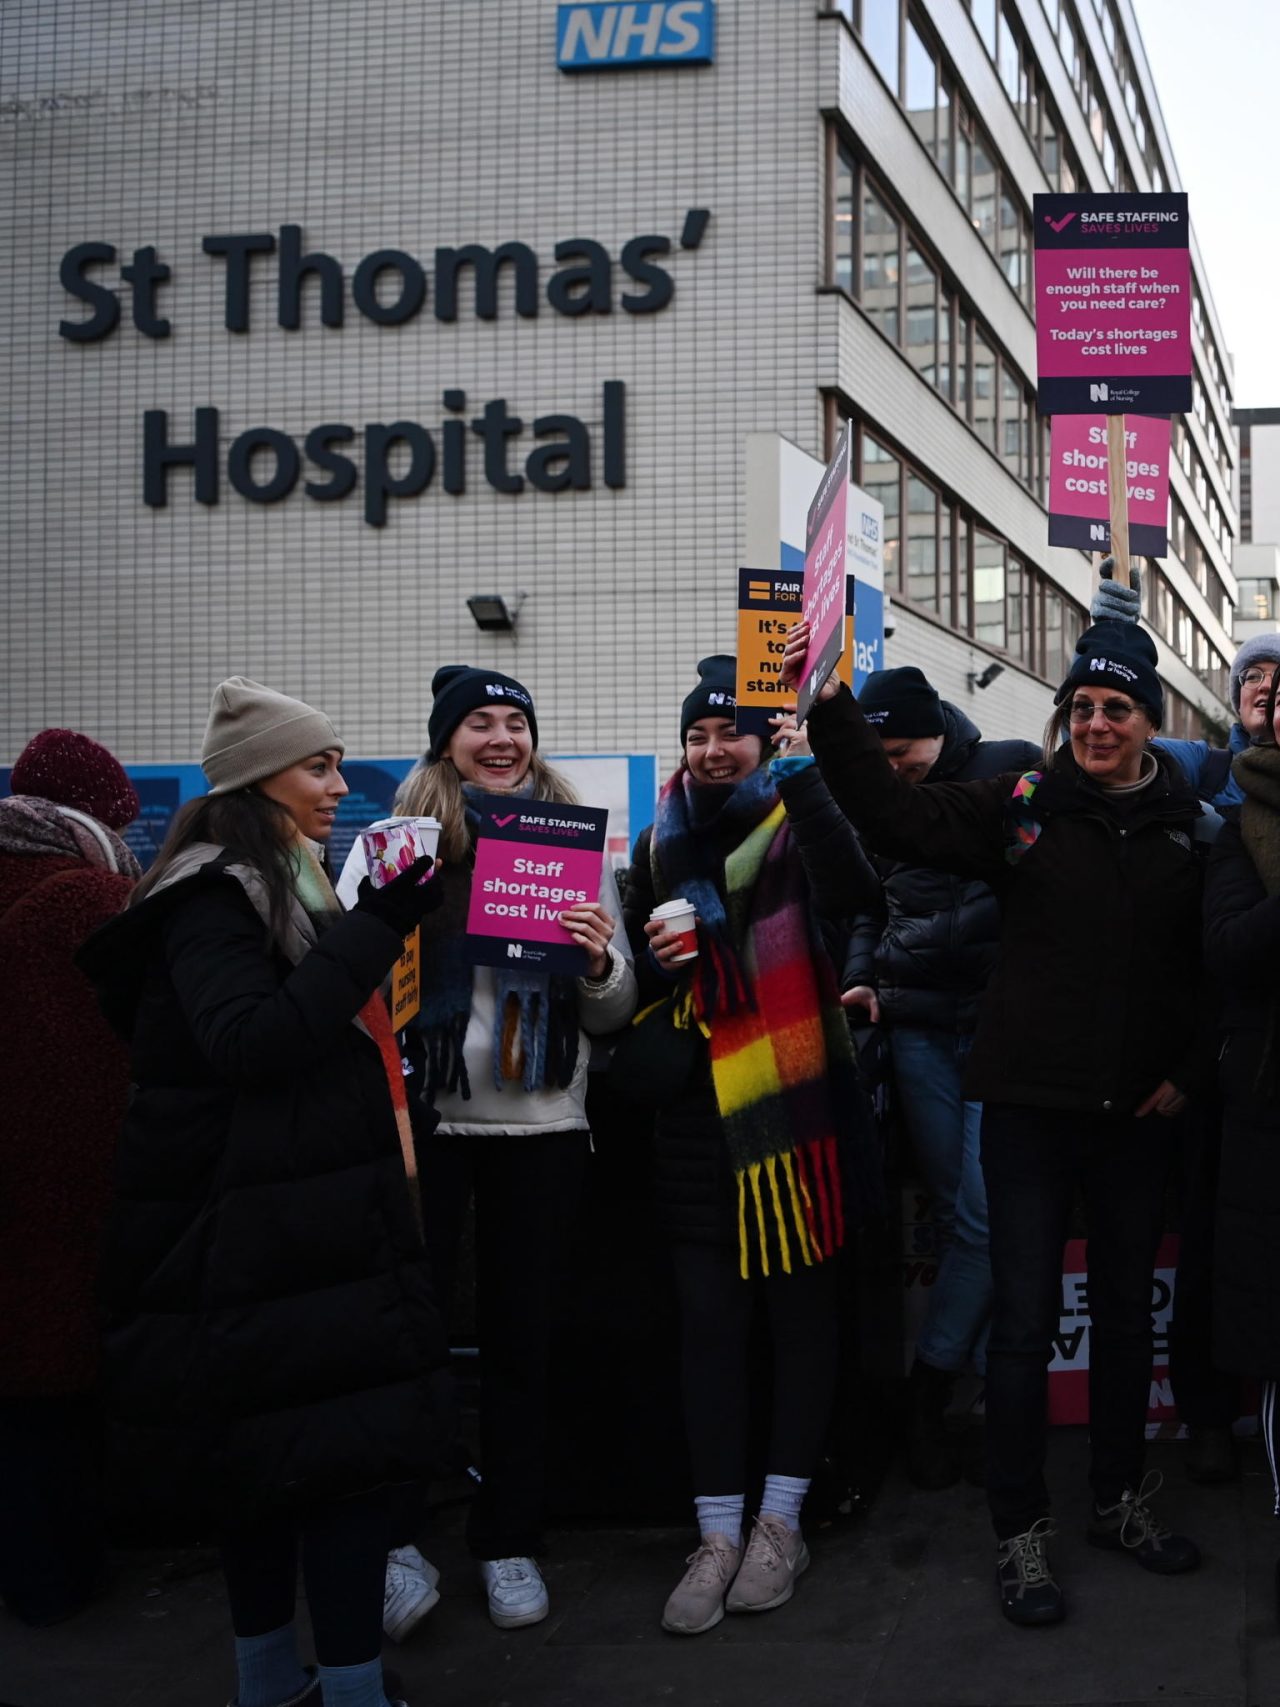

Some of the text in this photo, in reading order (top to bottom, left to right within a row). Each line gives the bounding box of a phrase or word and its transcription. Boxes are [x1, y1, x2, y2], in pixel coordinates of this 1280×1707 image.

[559, 1, 705, 60] NHS
[1080, 212, 1179, 223] SAFE STAFFING
[1080, 223, 1159, 233] SAVES LIVES
[1067, 267, 1159, 279] Will there be
[59, 240, 171, 343] St
[1046, 282, 1180, 296] enough staff when
[1060, 298, 1167, 312] you need care?
[1106, 328, 1178, 342] shortages
[1081, 344, 1147, 355] cost lives
[143, 379, 626, 529] Hospital
[1062, 449, 1160, 478] shorges
[1065, 478, 1107, 496] cost
[814, 523, 835, 577] Staff
[775, 582, 800, 592] FAIR
[774, 593, 796, 602] FOR
[767, 640, 786, 654] to
[518, 823, 580, 838] SAVES LIVES
[519, 814, 596, 832] SAFE STAFFING
[513, 858, 564, 877] Staff
[483, 877, 587, 903] shortages
[484, 902, 528, 918] cost
